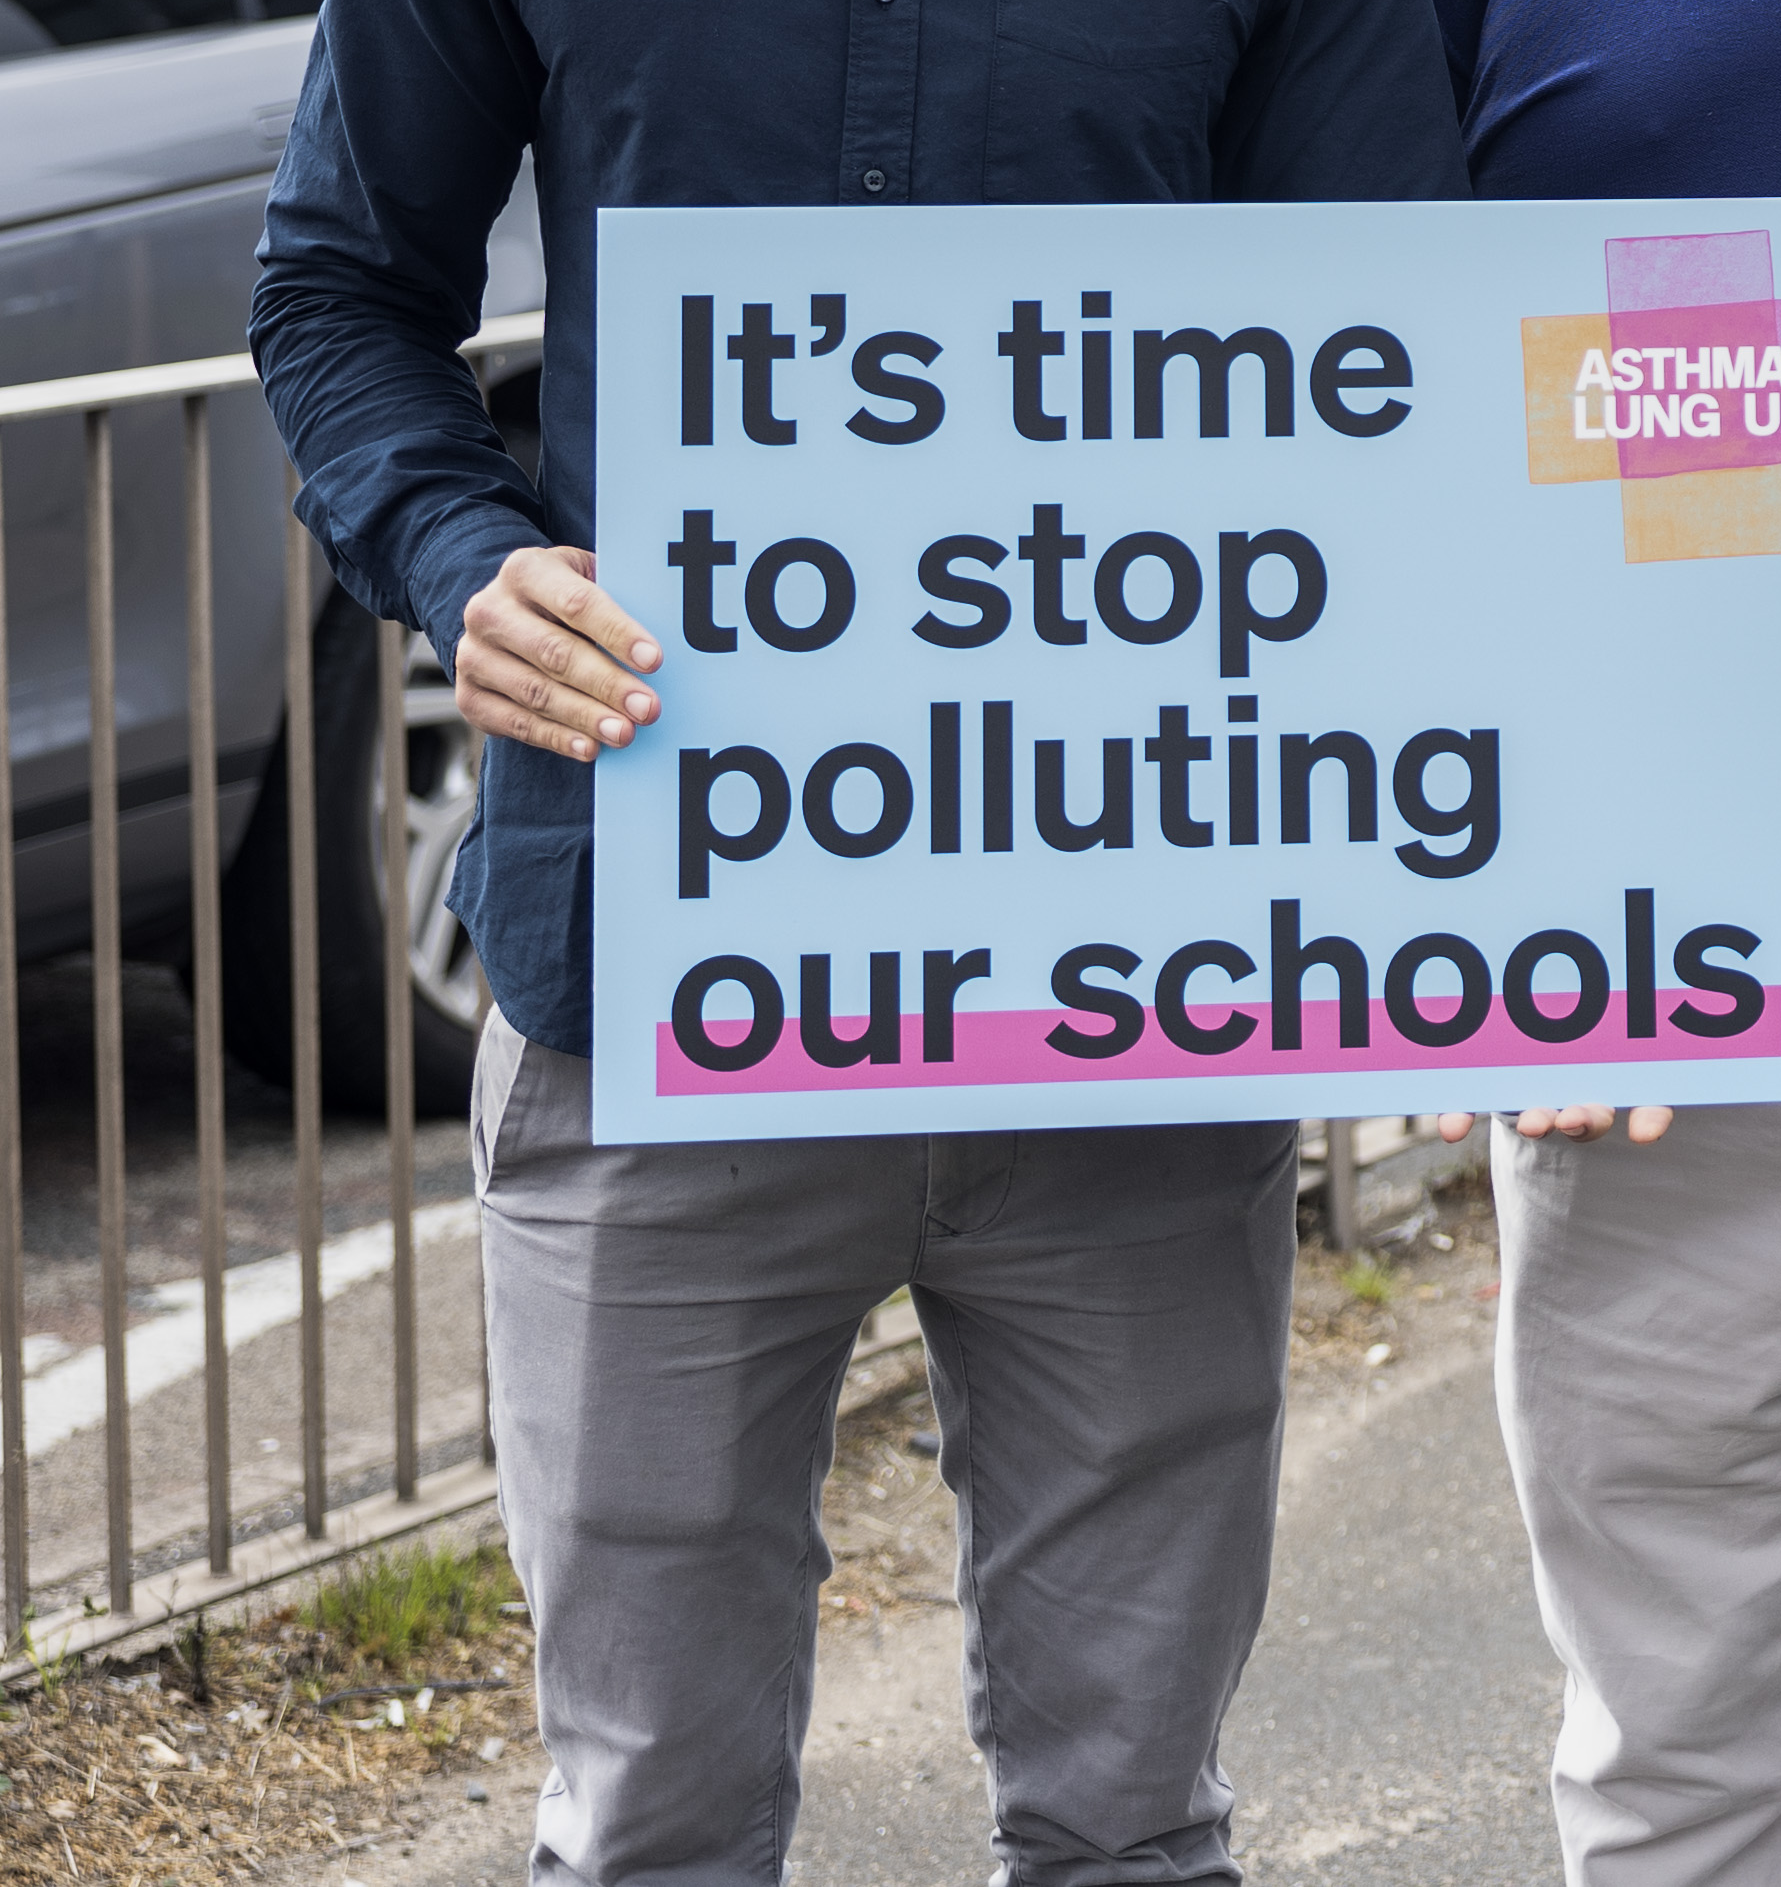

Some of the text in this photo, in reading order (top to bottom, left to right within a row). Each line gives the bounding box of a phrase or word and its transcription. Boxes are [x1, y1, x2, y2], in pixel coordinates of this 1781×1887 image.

[681, 290, 1414, 447] It’s time
[1573, 393, 1721, 440] LUNG
[667, 503, 1328, 679] to stop
[678, 694, 1501, 899] polluting
[671, 887, 1766, 1073] our schools
